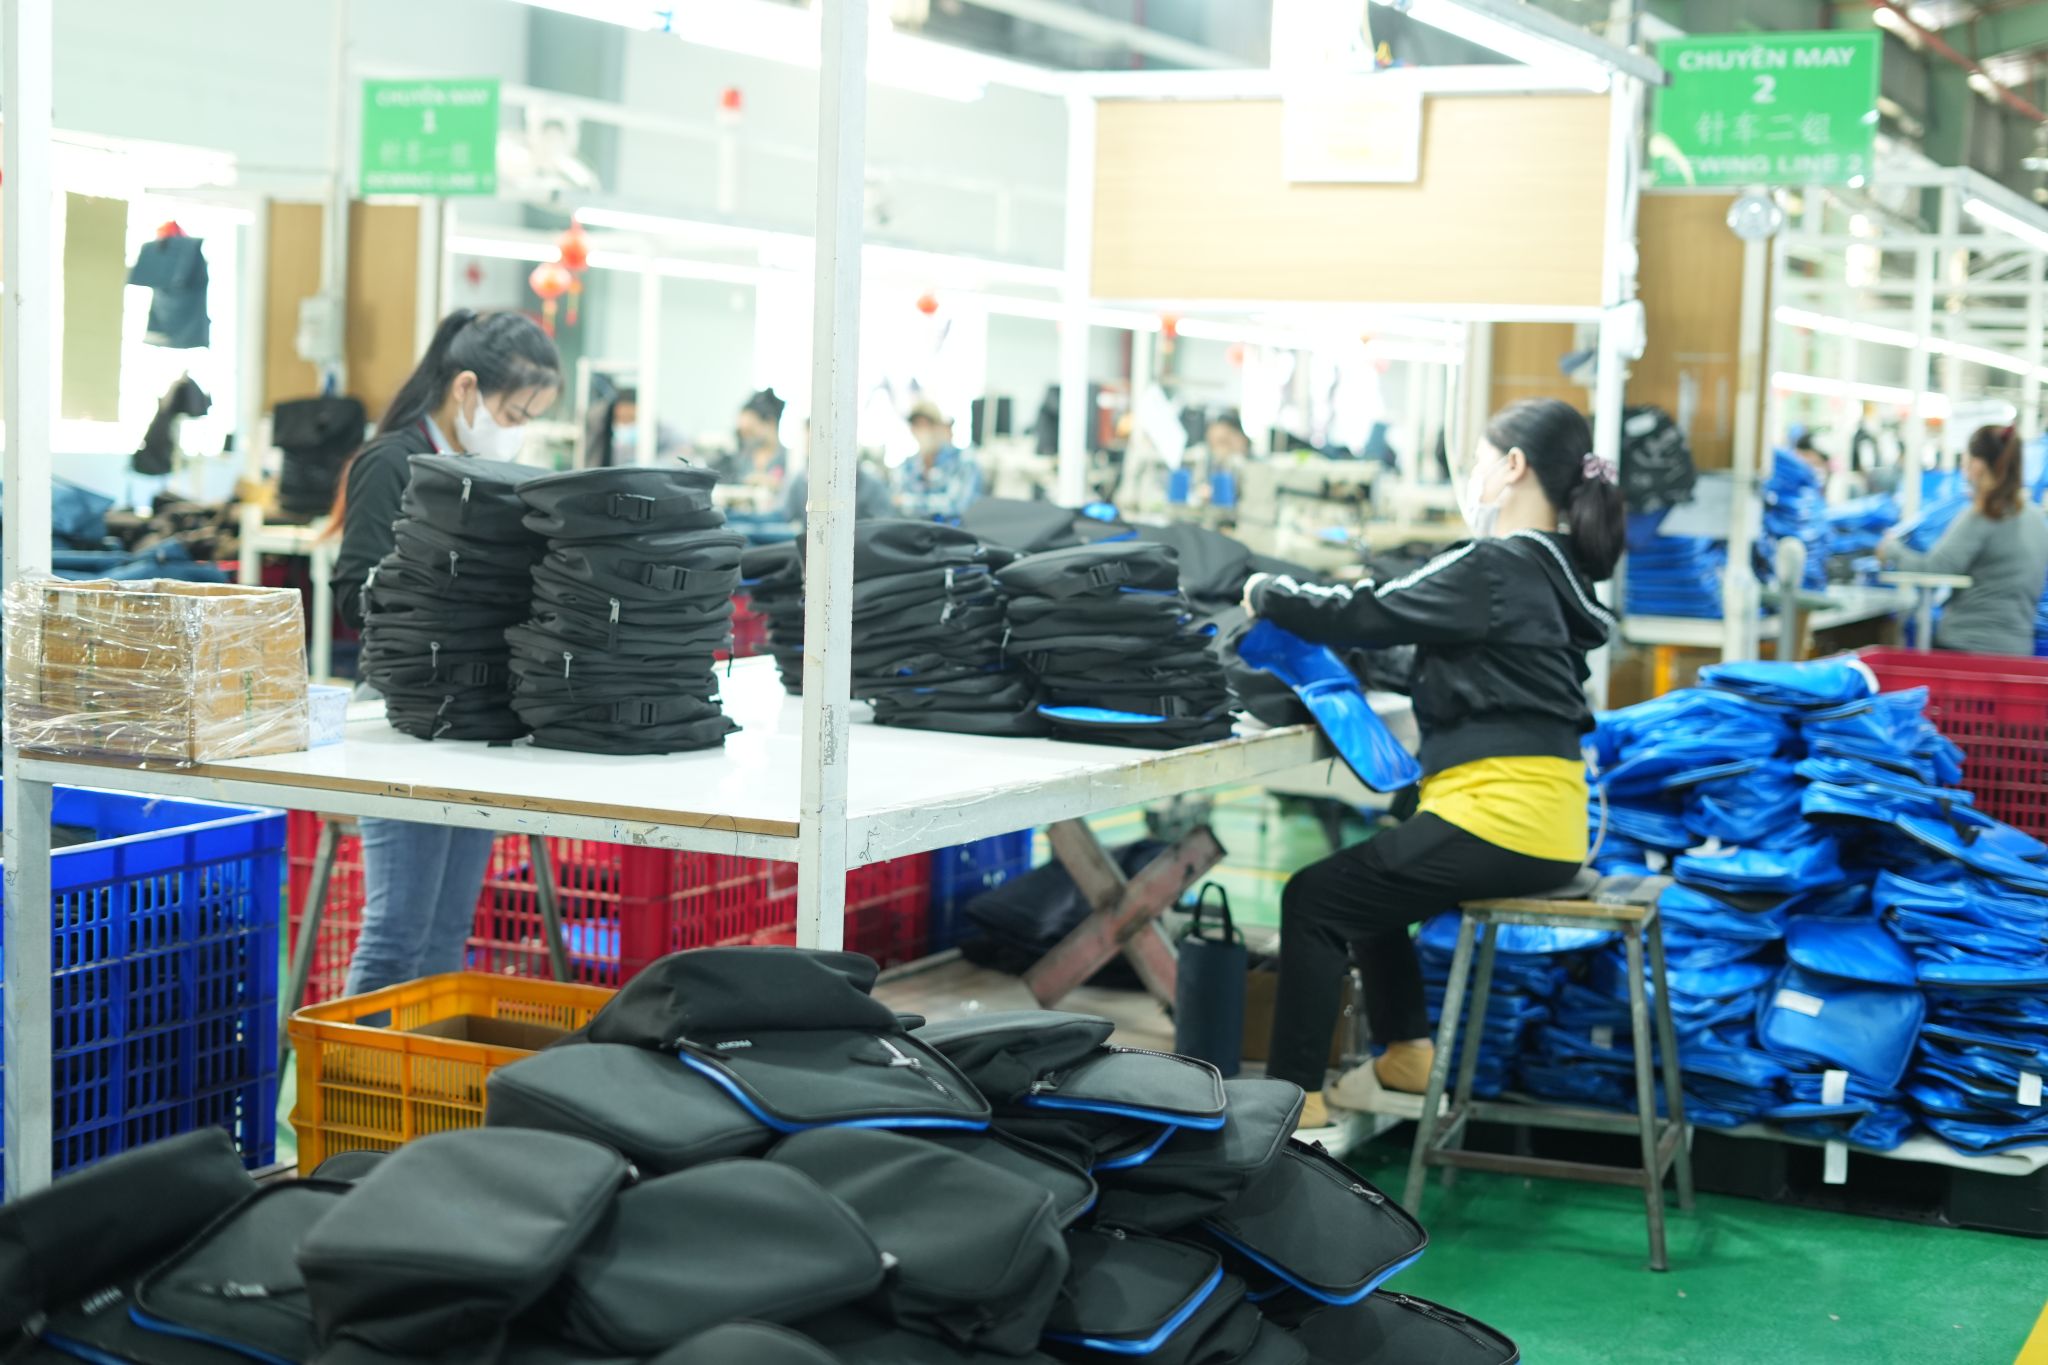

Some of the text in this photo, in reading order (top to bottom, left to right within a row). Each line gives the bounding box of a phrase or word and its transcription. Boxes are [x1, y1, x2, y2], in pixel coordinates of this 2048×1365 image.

[1793, 46, 1856, 67] MAY
[1751, 73, 1777, 105] 2
[1777, 152, 1840, 173] LINE
[1846, 153, 1864, 173] 2
